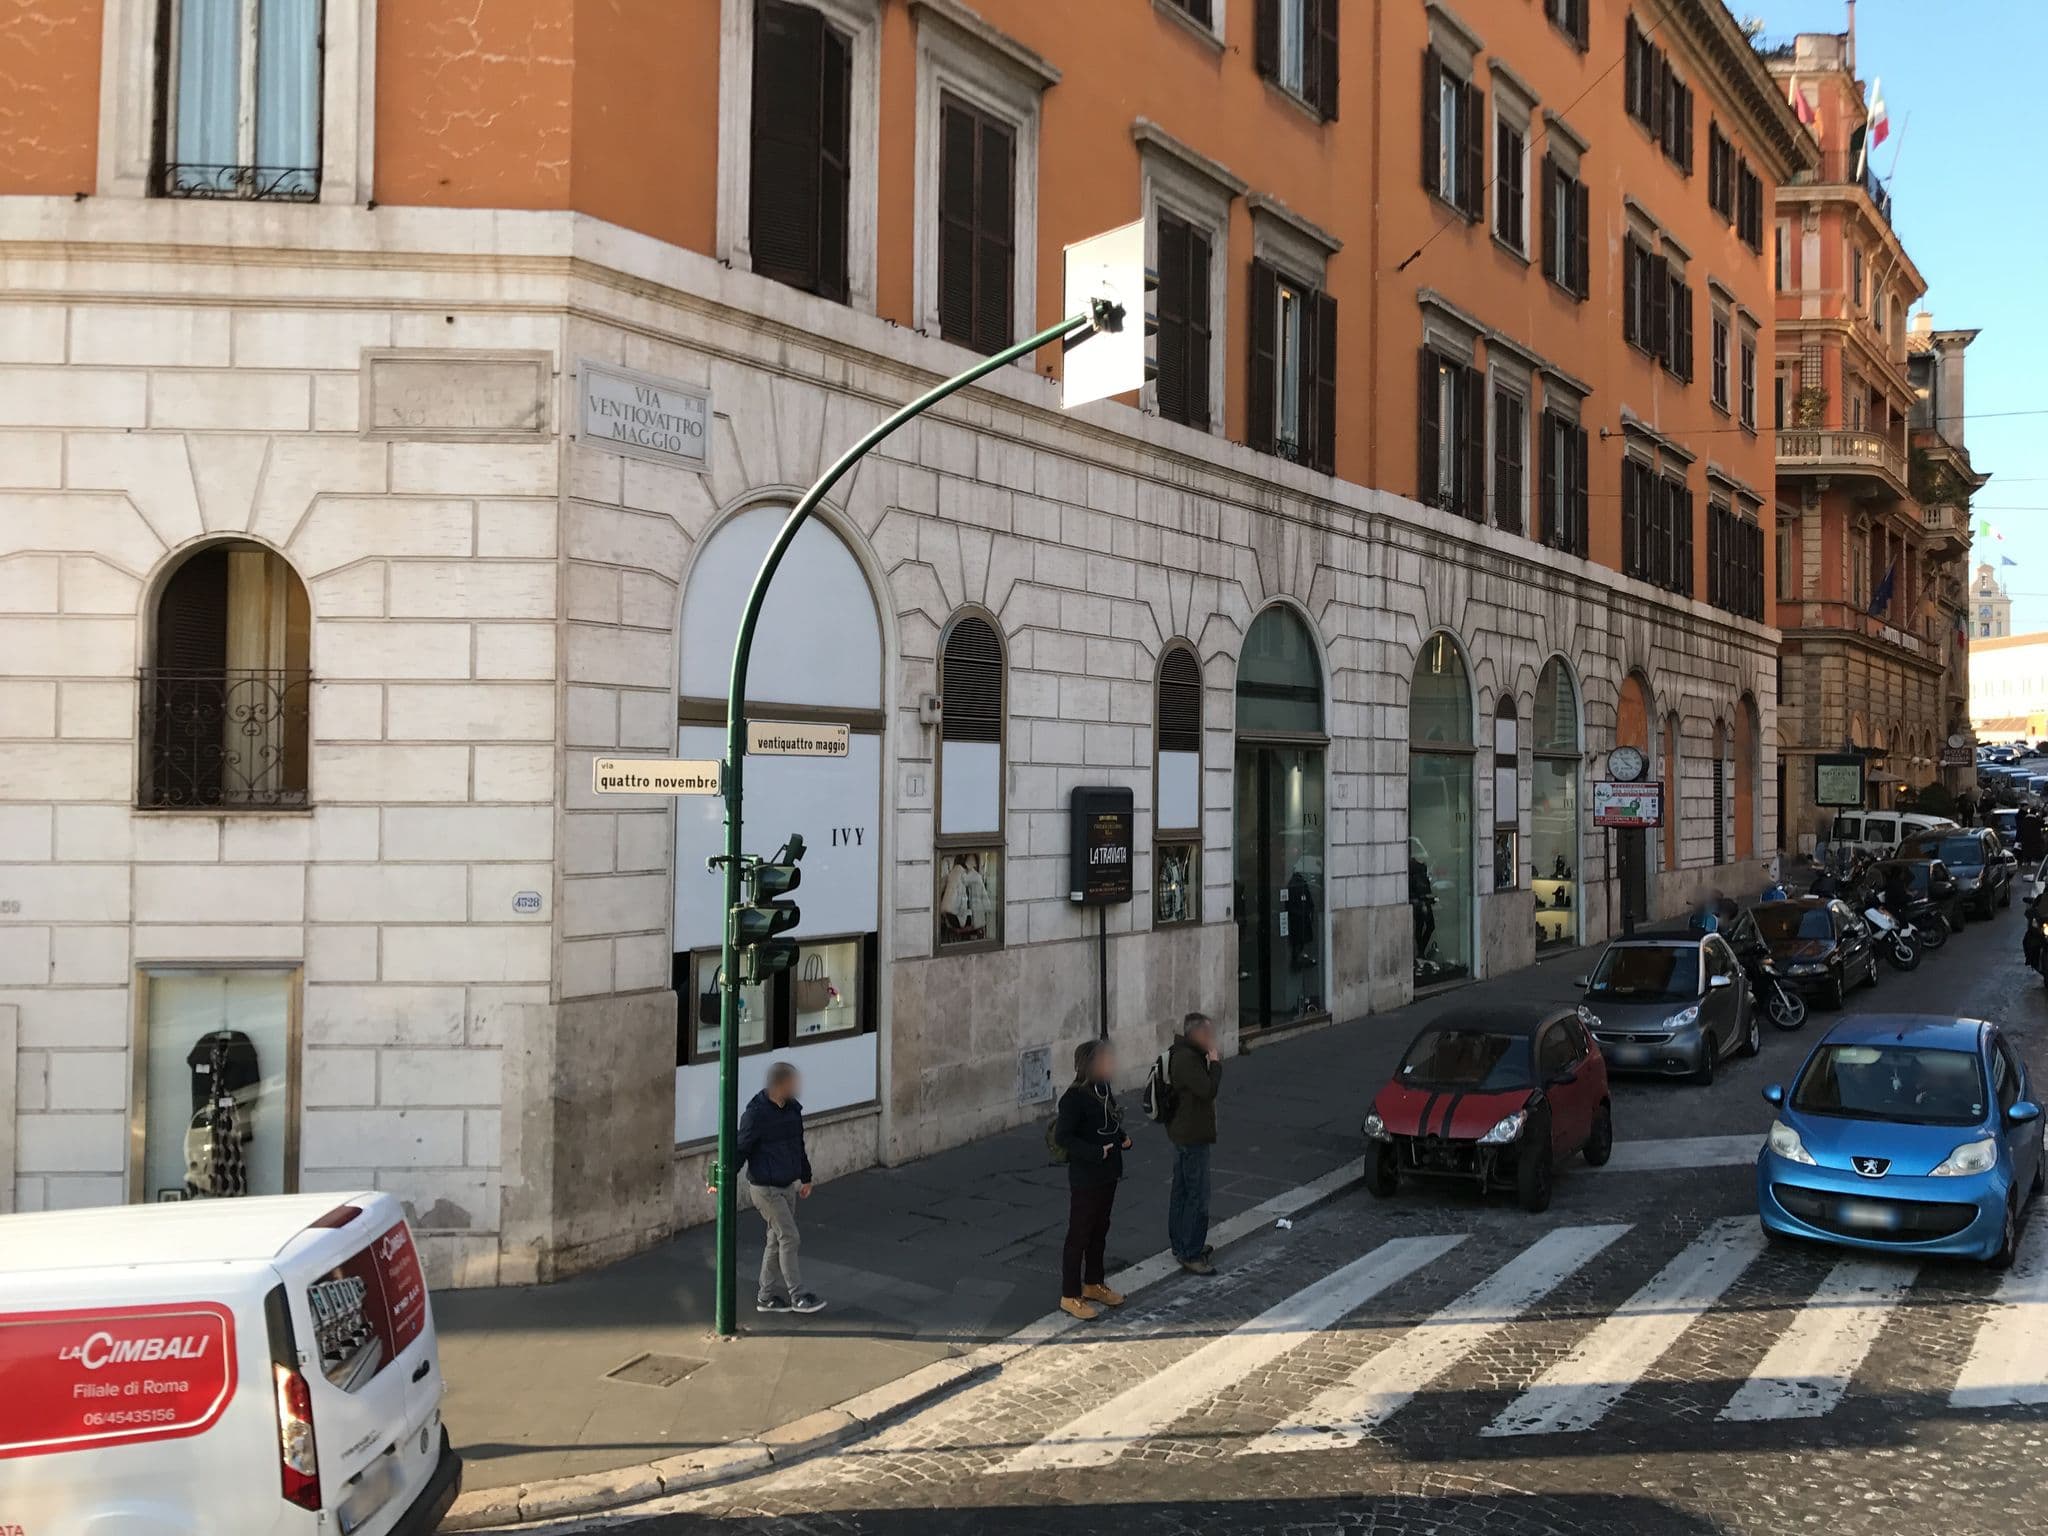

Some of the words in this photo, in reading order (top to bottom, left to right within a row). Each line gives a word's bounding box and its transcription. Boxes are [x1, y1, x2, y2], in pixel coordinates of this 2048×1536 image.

[635, 386, 661, 408] VIA
[612, 421, 682, 452] MAGGIO
[757, 735, 813, 753] ventiquattro
[815, 738, 846, 754] maggio
[601, 762, 614, 770] via
[600, 774, 650, 790] quattro
[654, 775, 718, 789] novembre
[831, 827, 865, 846] IVY
[81, 1331, 210, 1370] CIMBALI
[73, 1382, 120, 1399] Filiale
[123, 1381, 139, 1396] di
[143, 1379, 190, 1395] Roma
[83, 1408, 176, 1426] 06/45435156
